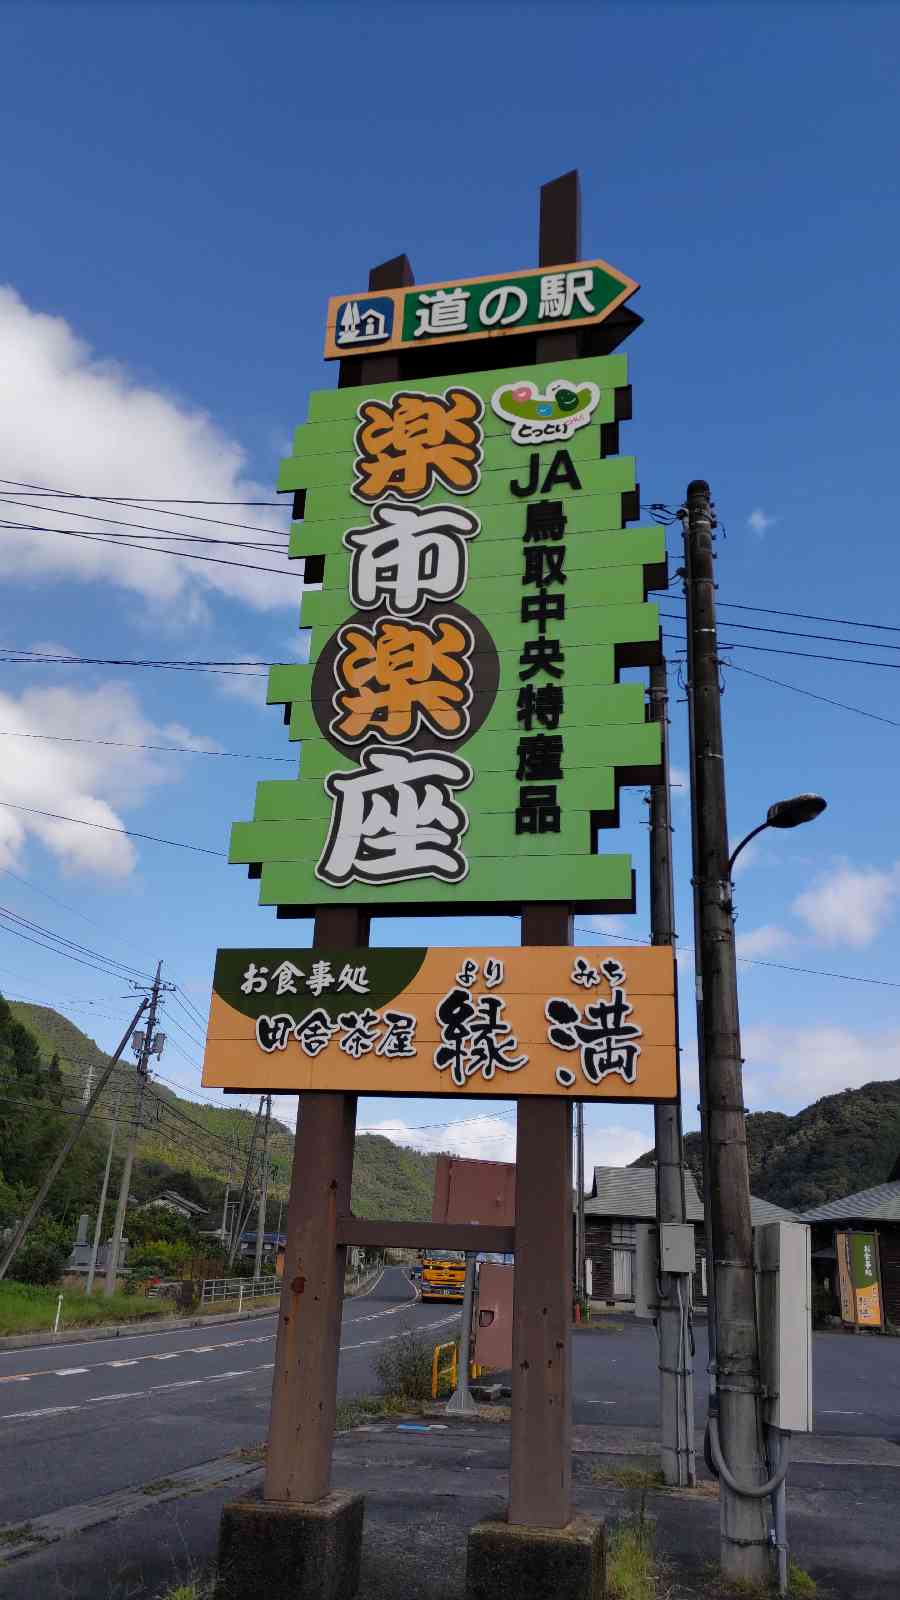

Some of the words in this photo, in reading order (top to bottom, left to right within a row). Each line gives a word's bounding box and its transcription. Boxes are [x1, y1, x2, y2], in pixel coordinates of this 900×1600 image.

[413, 269, 596, 337] 道の駅
[518, 423, 568, 437] とっとり
[314, 387, 485, 887] 楽市楽座
[240, 960, 371, 996] お食事処
[455, 958, 504, 988] より
[570, 956, 626, 988] みち
[256, 1008, 417, 1058] 田舎茶屋
